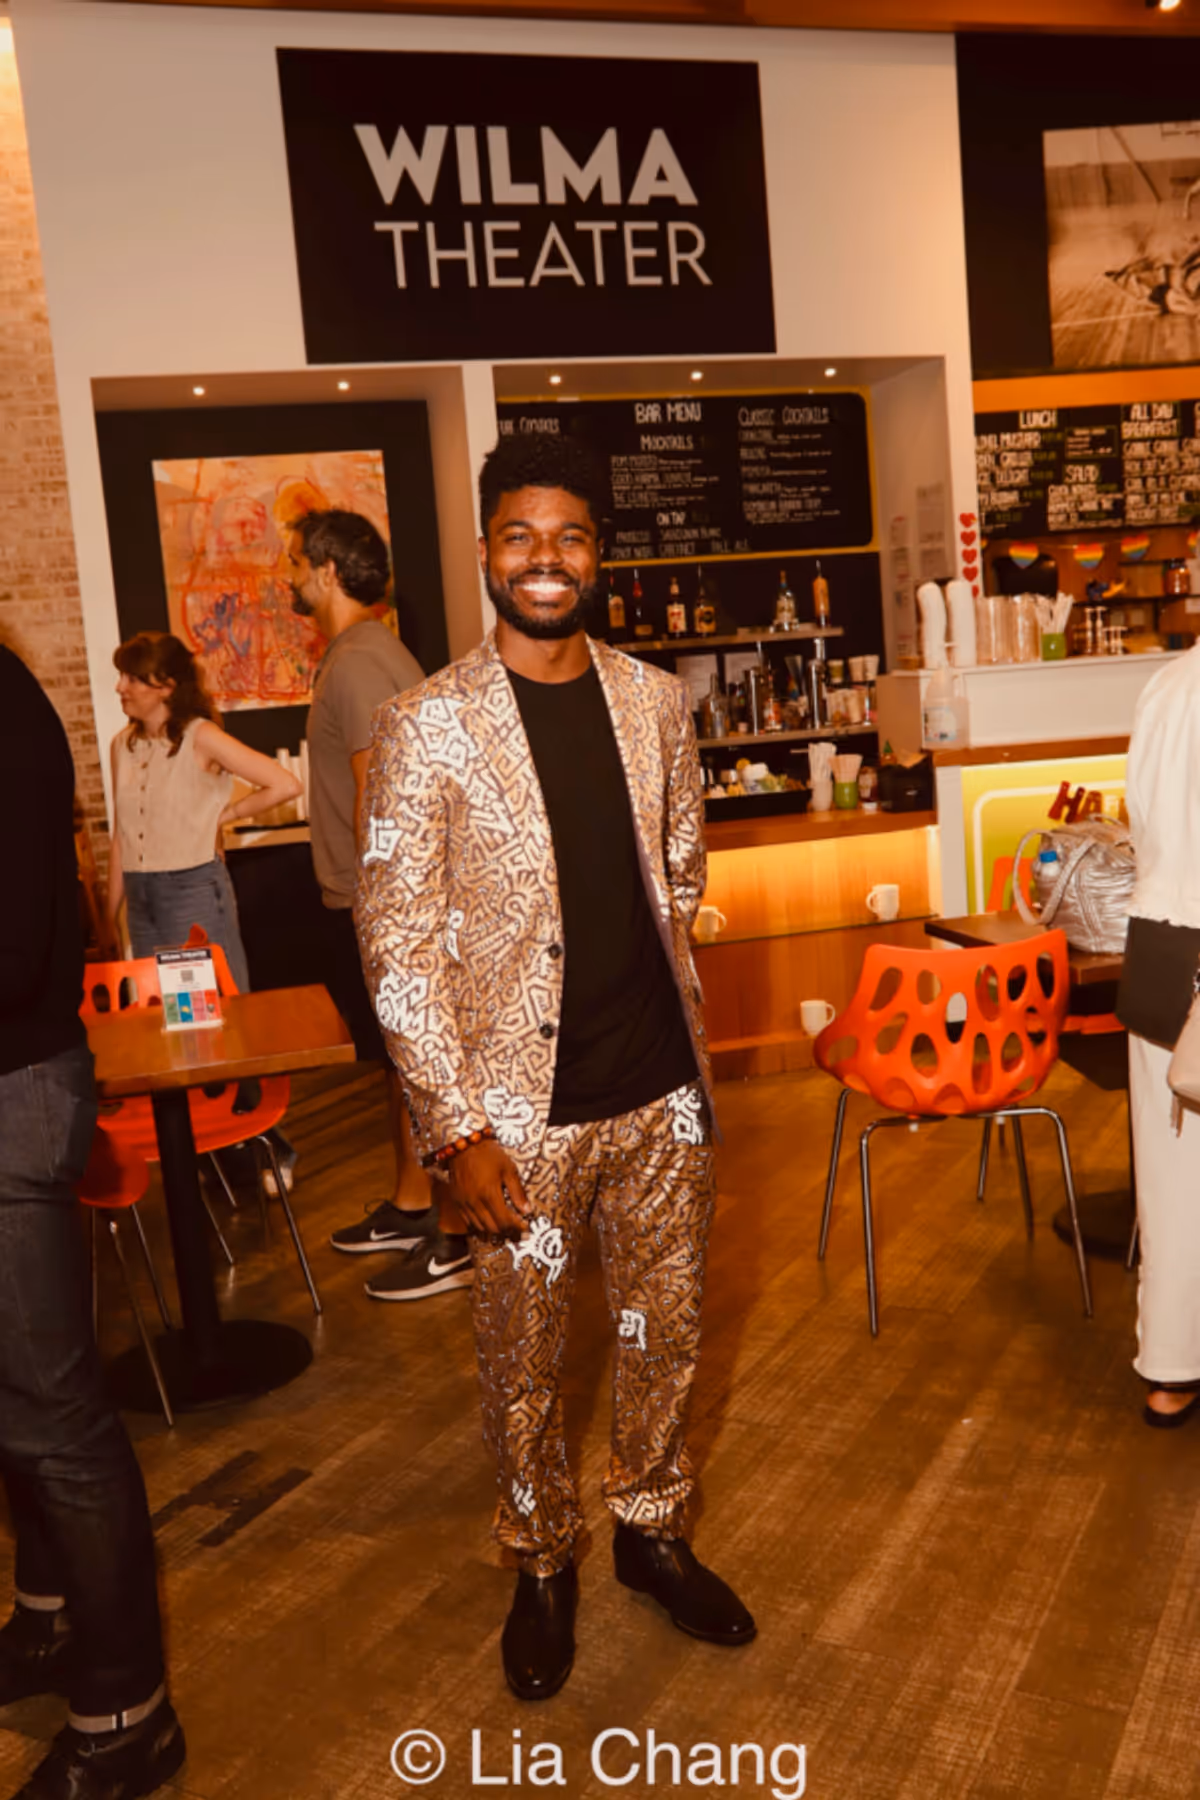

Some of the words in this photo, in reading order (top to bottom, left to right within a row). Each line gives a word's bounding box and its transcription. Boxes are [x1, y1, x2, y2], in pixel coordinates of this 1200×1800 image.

[354, 123, 698, 206] WILMA
[374, 221, 713, 288] THEATER
[634, 402, 662, 424] BAR
[666, 401, 702, 422] MENU
[1019, 409, 1057, 429] LUNCH
[1130, 403, 1149, 420] ALL
[1151, 402, 1174, 419] DAY
[1121, 419, 1178, 439] BREAKFAST
[640, 434, 694, 451] MOCKTAILS
[1064, 464, 1099, 483] SALAD
